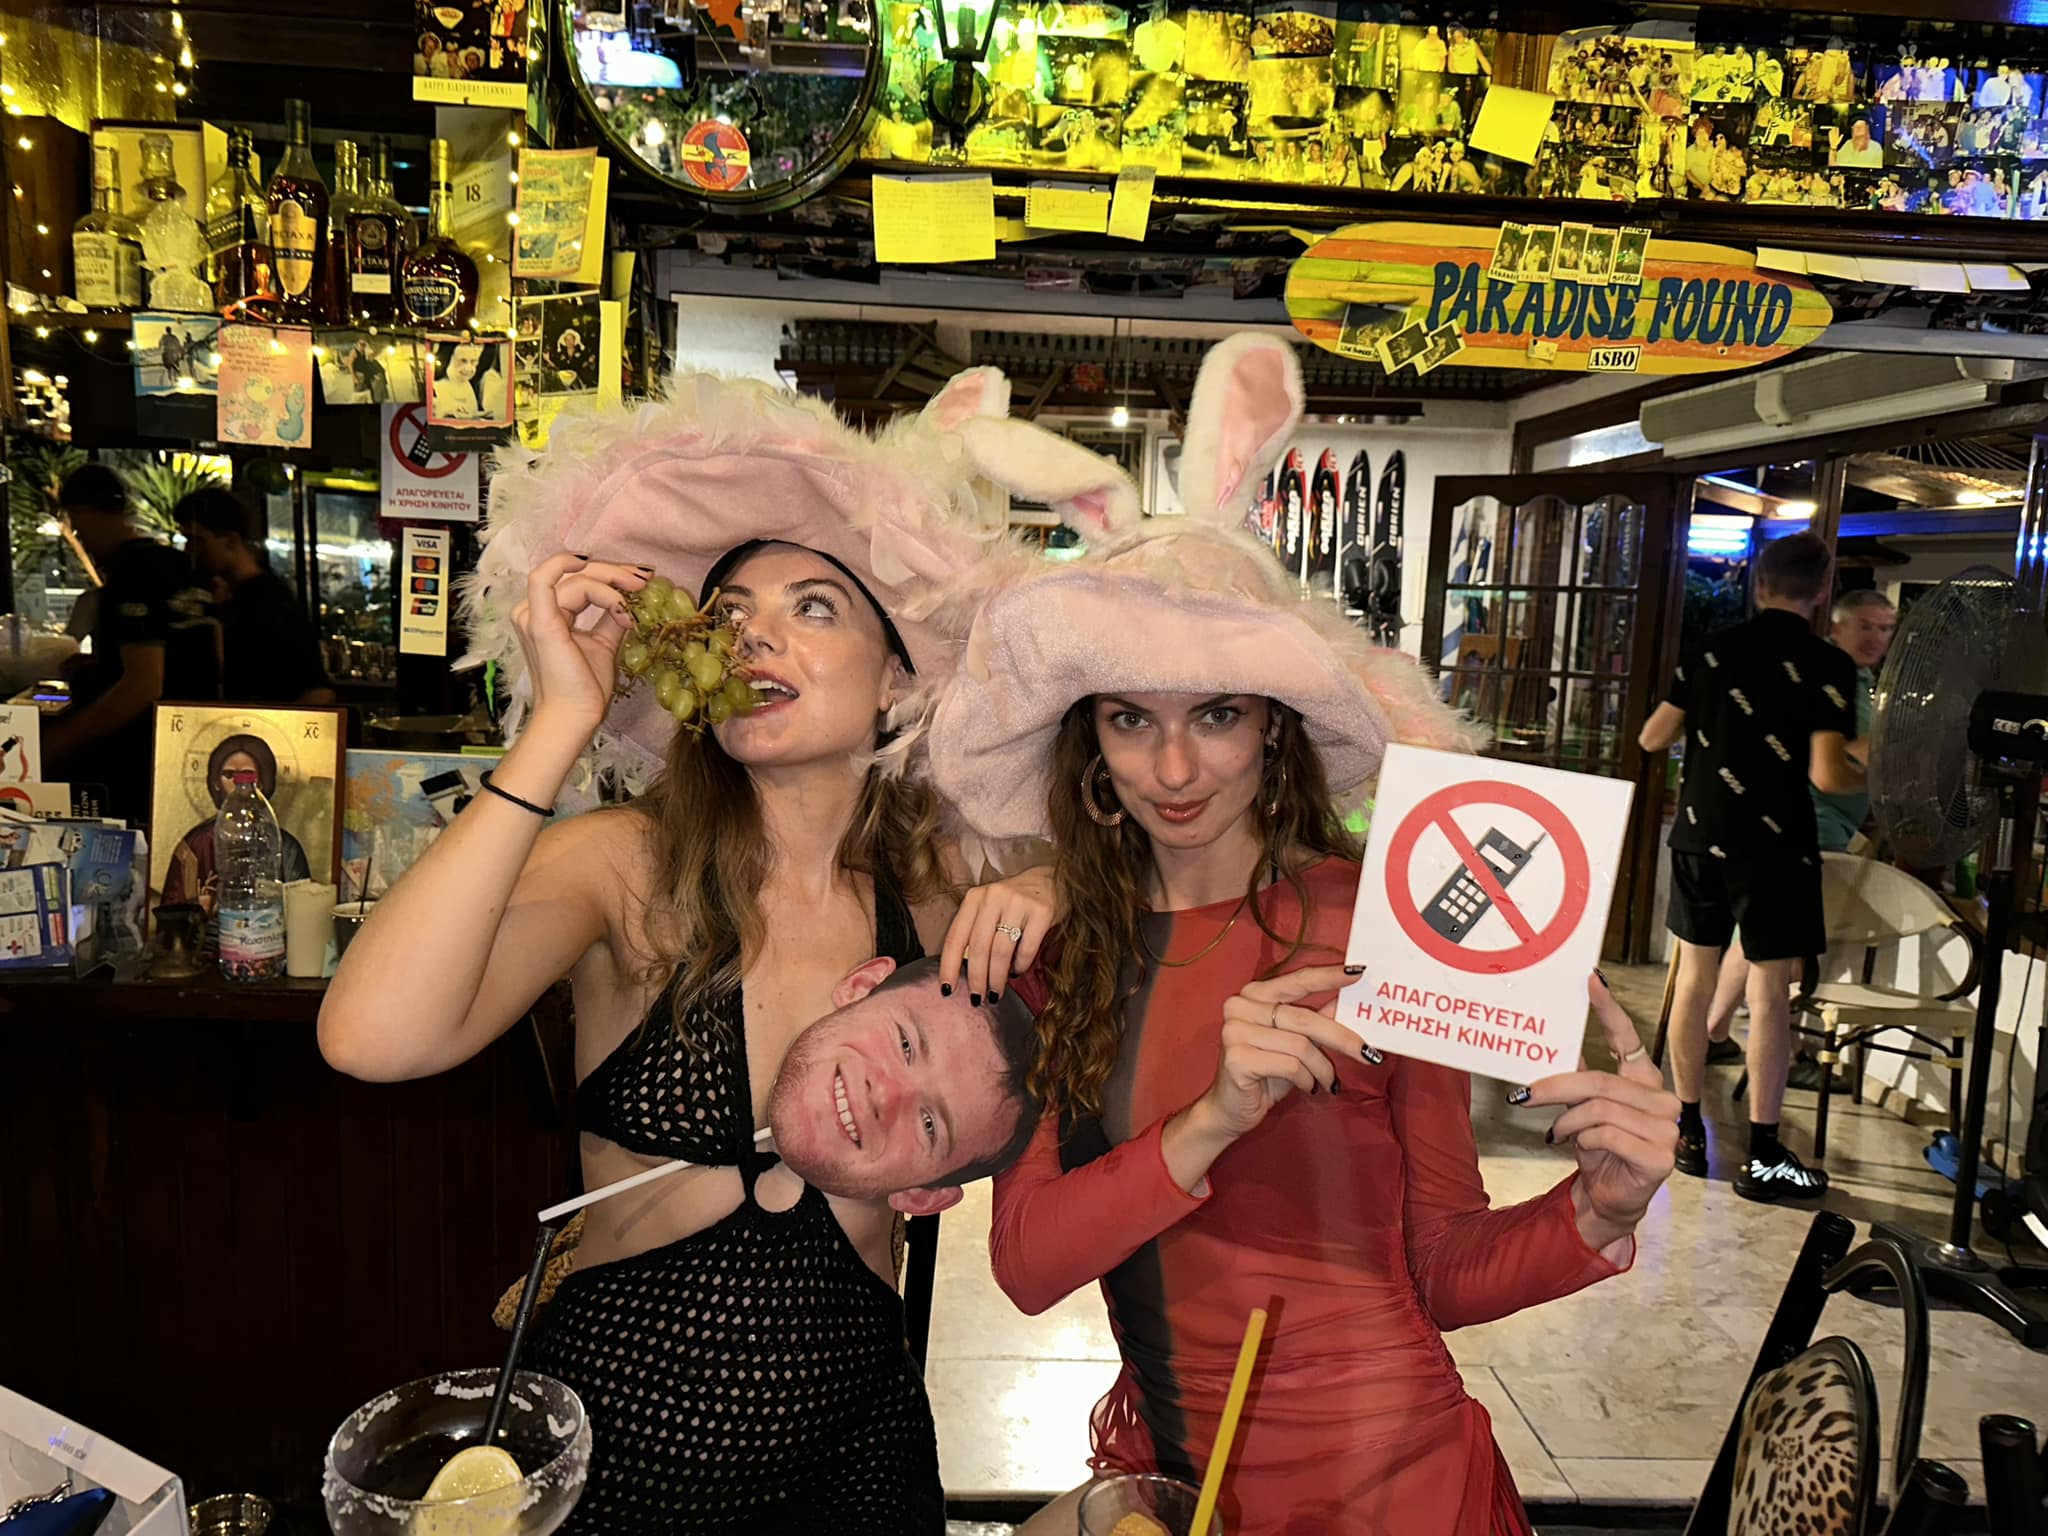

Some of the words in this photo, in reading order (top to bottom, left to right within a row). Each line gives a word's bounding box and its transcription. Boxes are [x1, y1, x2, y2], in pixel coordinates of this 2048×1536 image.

[466, 183, 481, 202] 18
[1427, 260, 1640, 341] PARADISE
[1646, 277, 1793, 348] FOUND
[1590, 351, 1635, 367] ASBO
[396, 488, 464, 499] ΑΠΑΓΟΡΕΥΕΤΑΙ
[398, 499, 429, 509] ΧΡΗΣΗ
[431, 501, 471, 511] ΚΙΝΗΤΟΥ
[415, 539, 437, 549] VISA
[1376, 981, 1546, 1036] ΑΠΑΓΟΡΕΥΕΤΑΙ
[1356, 1002, 1372, 1020] Η
[1378, 1007, 1451, 1040] ΧΡΗΣΗ
[1457, 1026, 1559, 1064] ΚΙΝΗΤΟΥ
